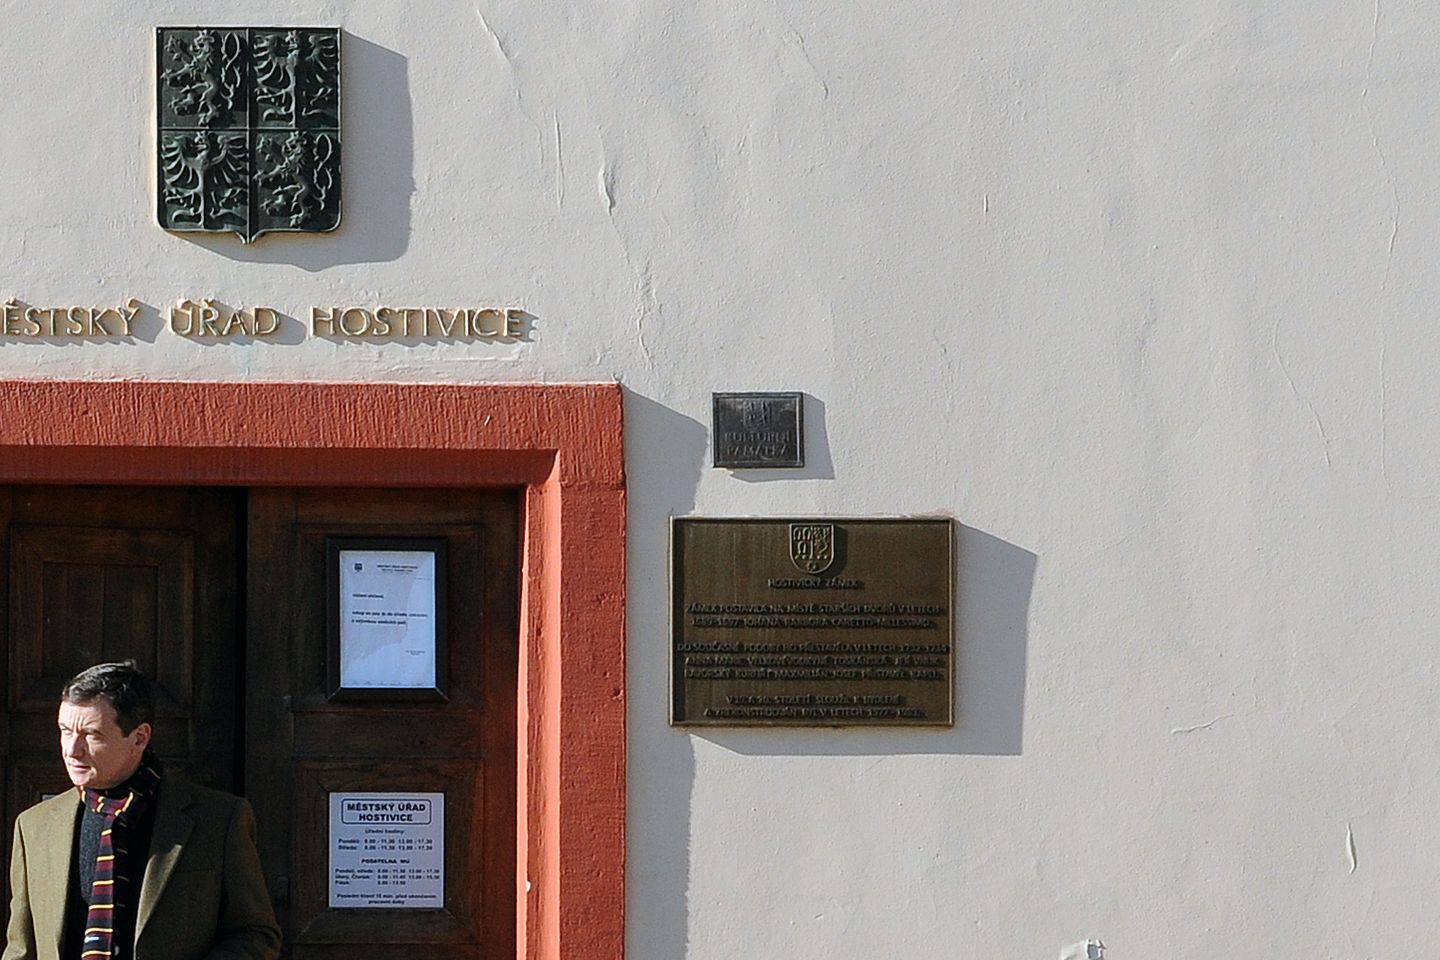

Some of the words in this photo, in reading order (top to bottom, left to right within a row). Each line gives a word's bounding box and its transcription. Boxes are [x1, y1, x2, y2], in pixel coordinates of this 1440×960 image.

[168, 298, 280, 337] ÚŘAD
[312, 305, 523, 338] HOSTIVICE
[347, 801, 395, 812] MĚSTSKÝ
[397, 801, 426, 812] ÚŘAD
[358, 813, 413, 822] HOSTIVICE
